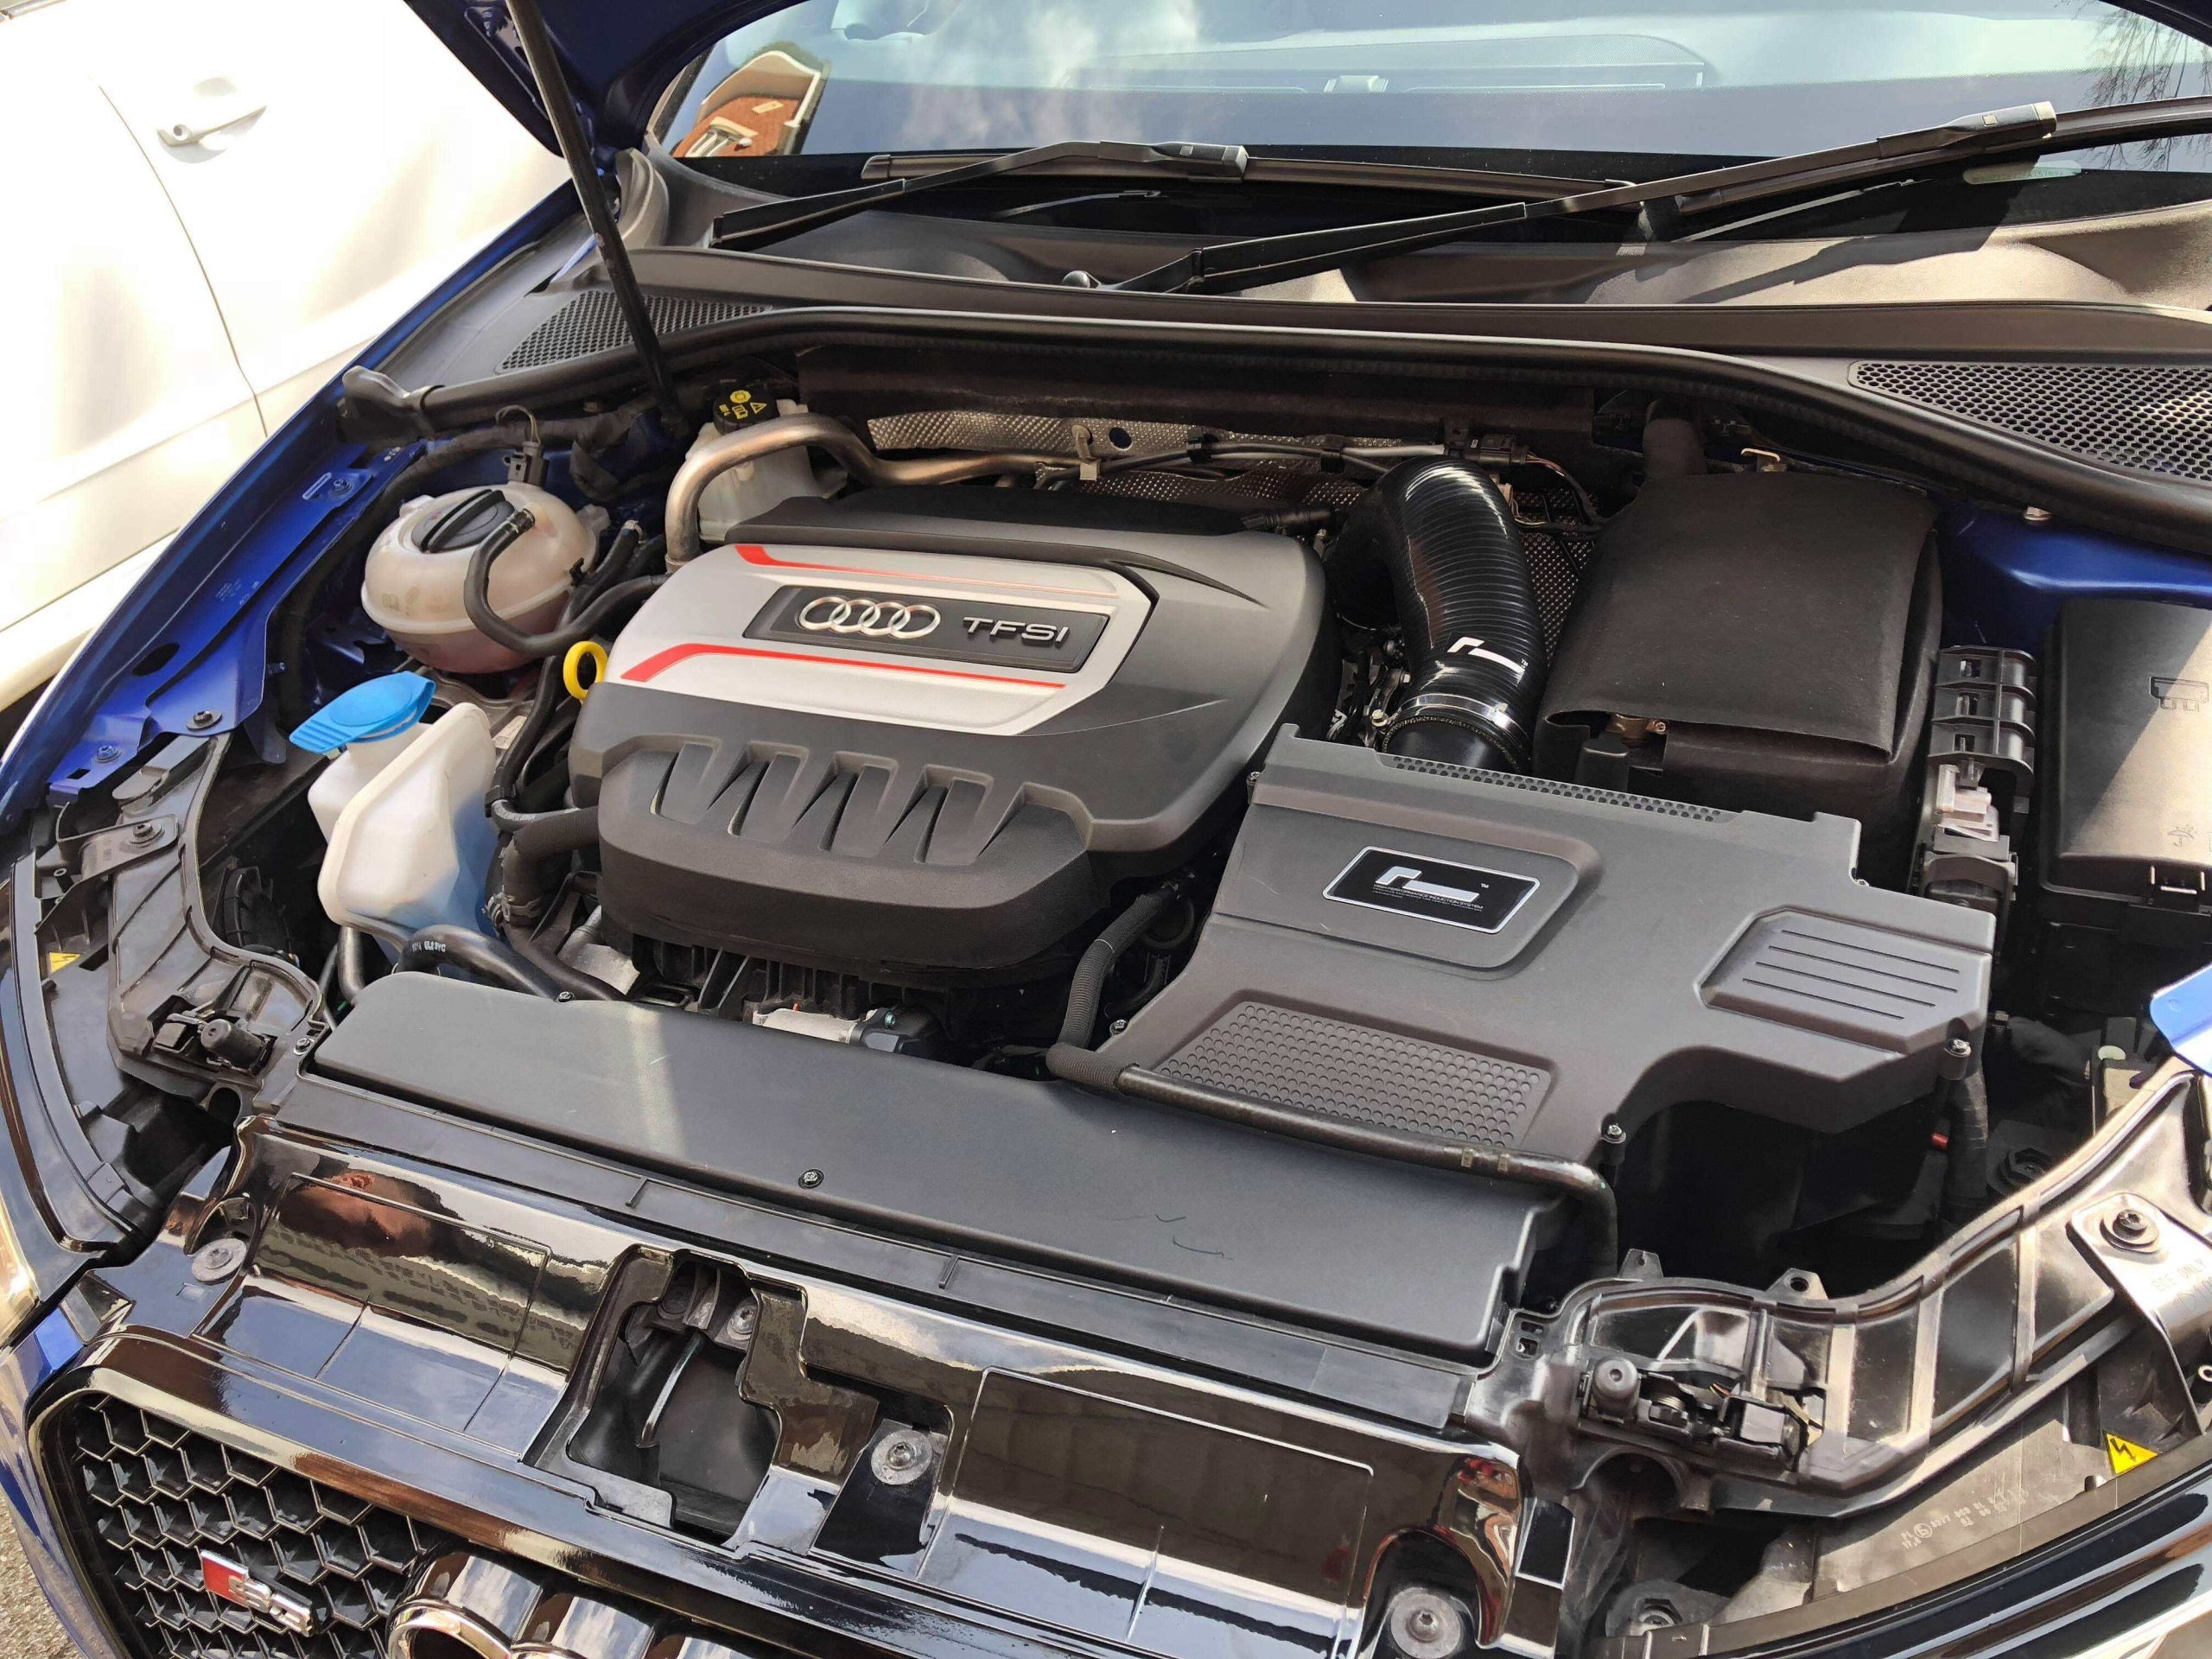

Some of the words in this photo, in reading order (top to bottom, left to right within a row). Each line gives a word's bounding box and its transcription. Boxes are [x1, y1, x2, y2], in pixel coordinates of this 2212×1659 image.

[963, 616, 1071, 645] TFSI
[1388, 887, 1429, 898] PERFORMANCE
[1459, 900, 1484, 909] SYSTEM
